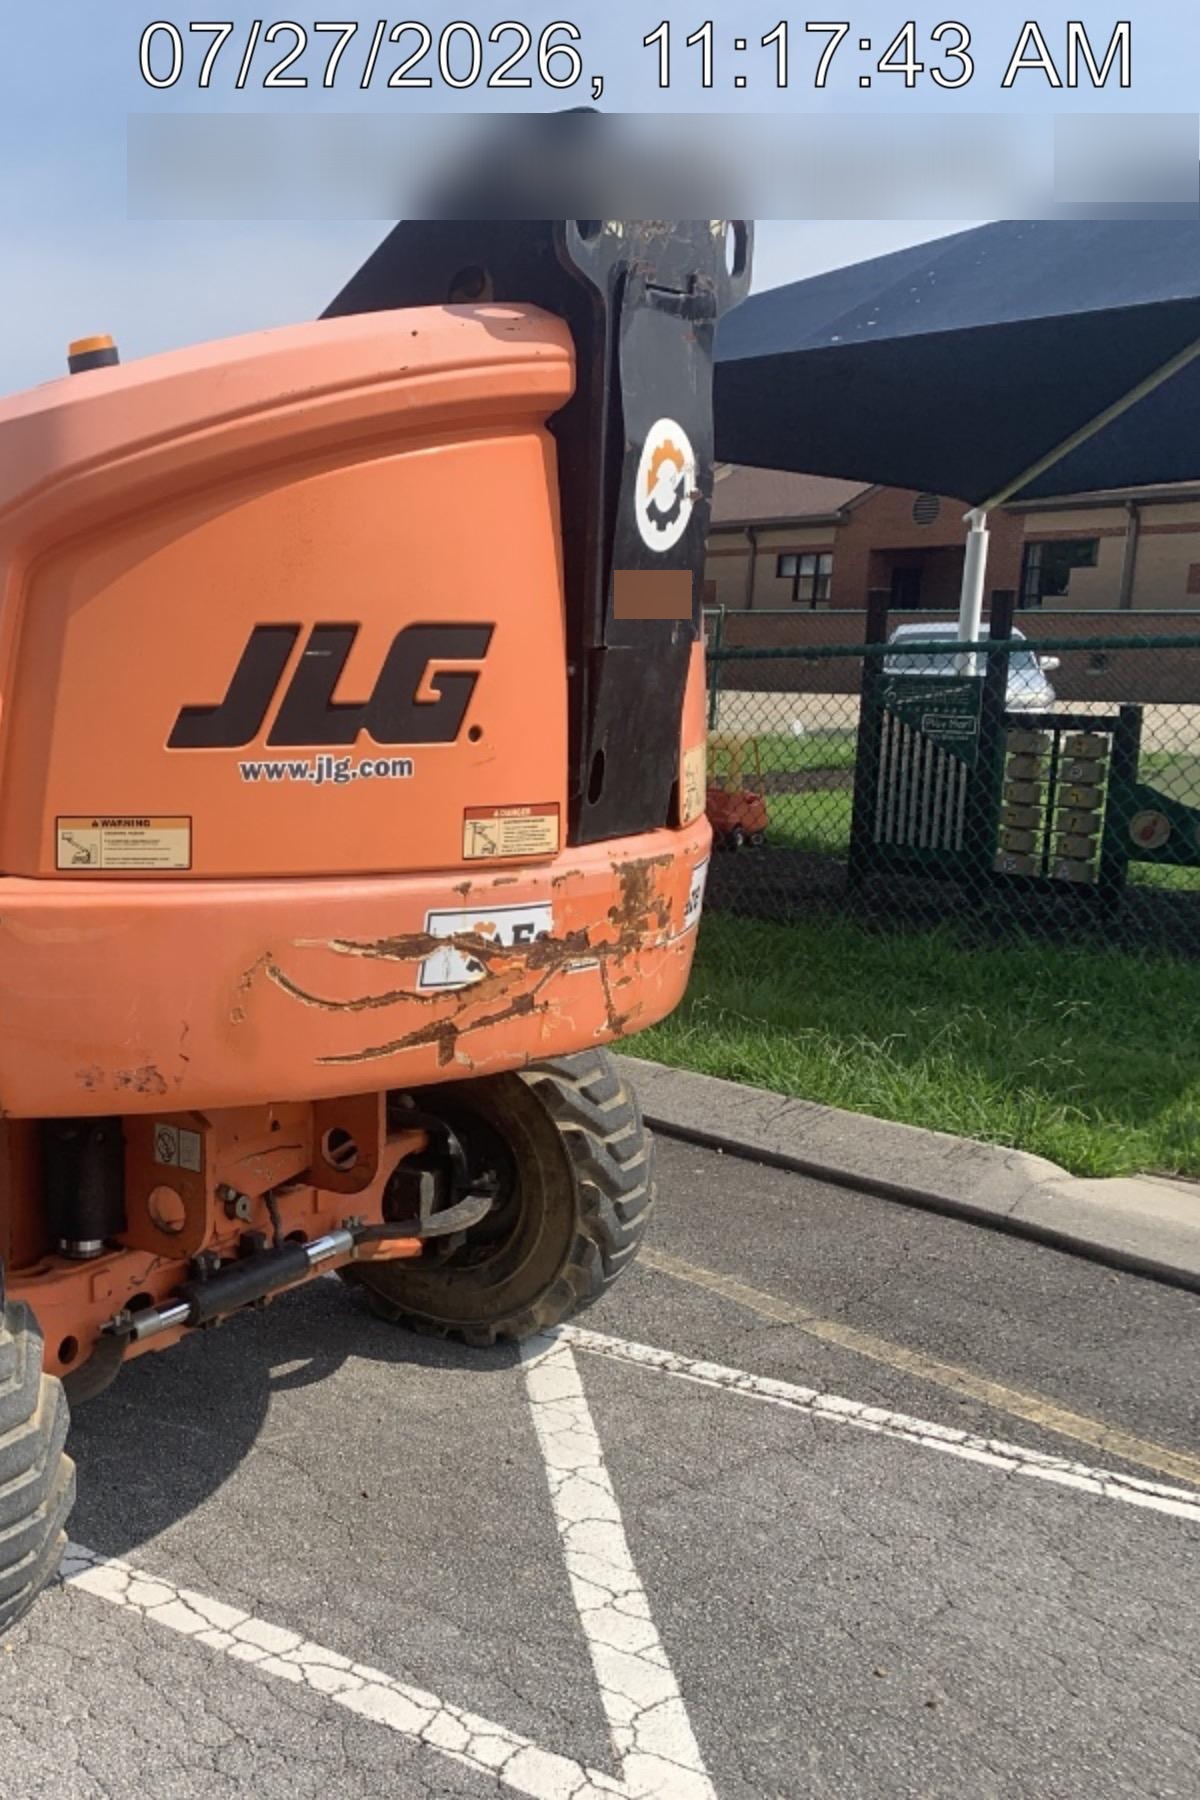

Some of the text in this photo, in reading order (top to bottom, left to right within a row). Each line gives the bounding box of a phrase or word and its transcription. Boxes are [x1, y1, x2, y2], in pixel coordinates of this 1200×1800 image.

[165, 622, 496, 750] JLG
[239, 754, 414, 784] www.jlg.com
[100, 819, 151, 828] WARNING
